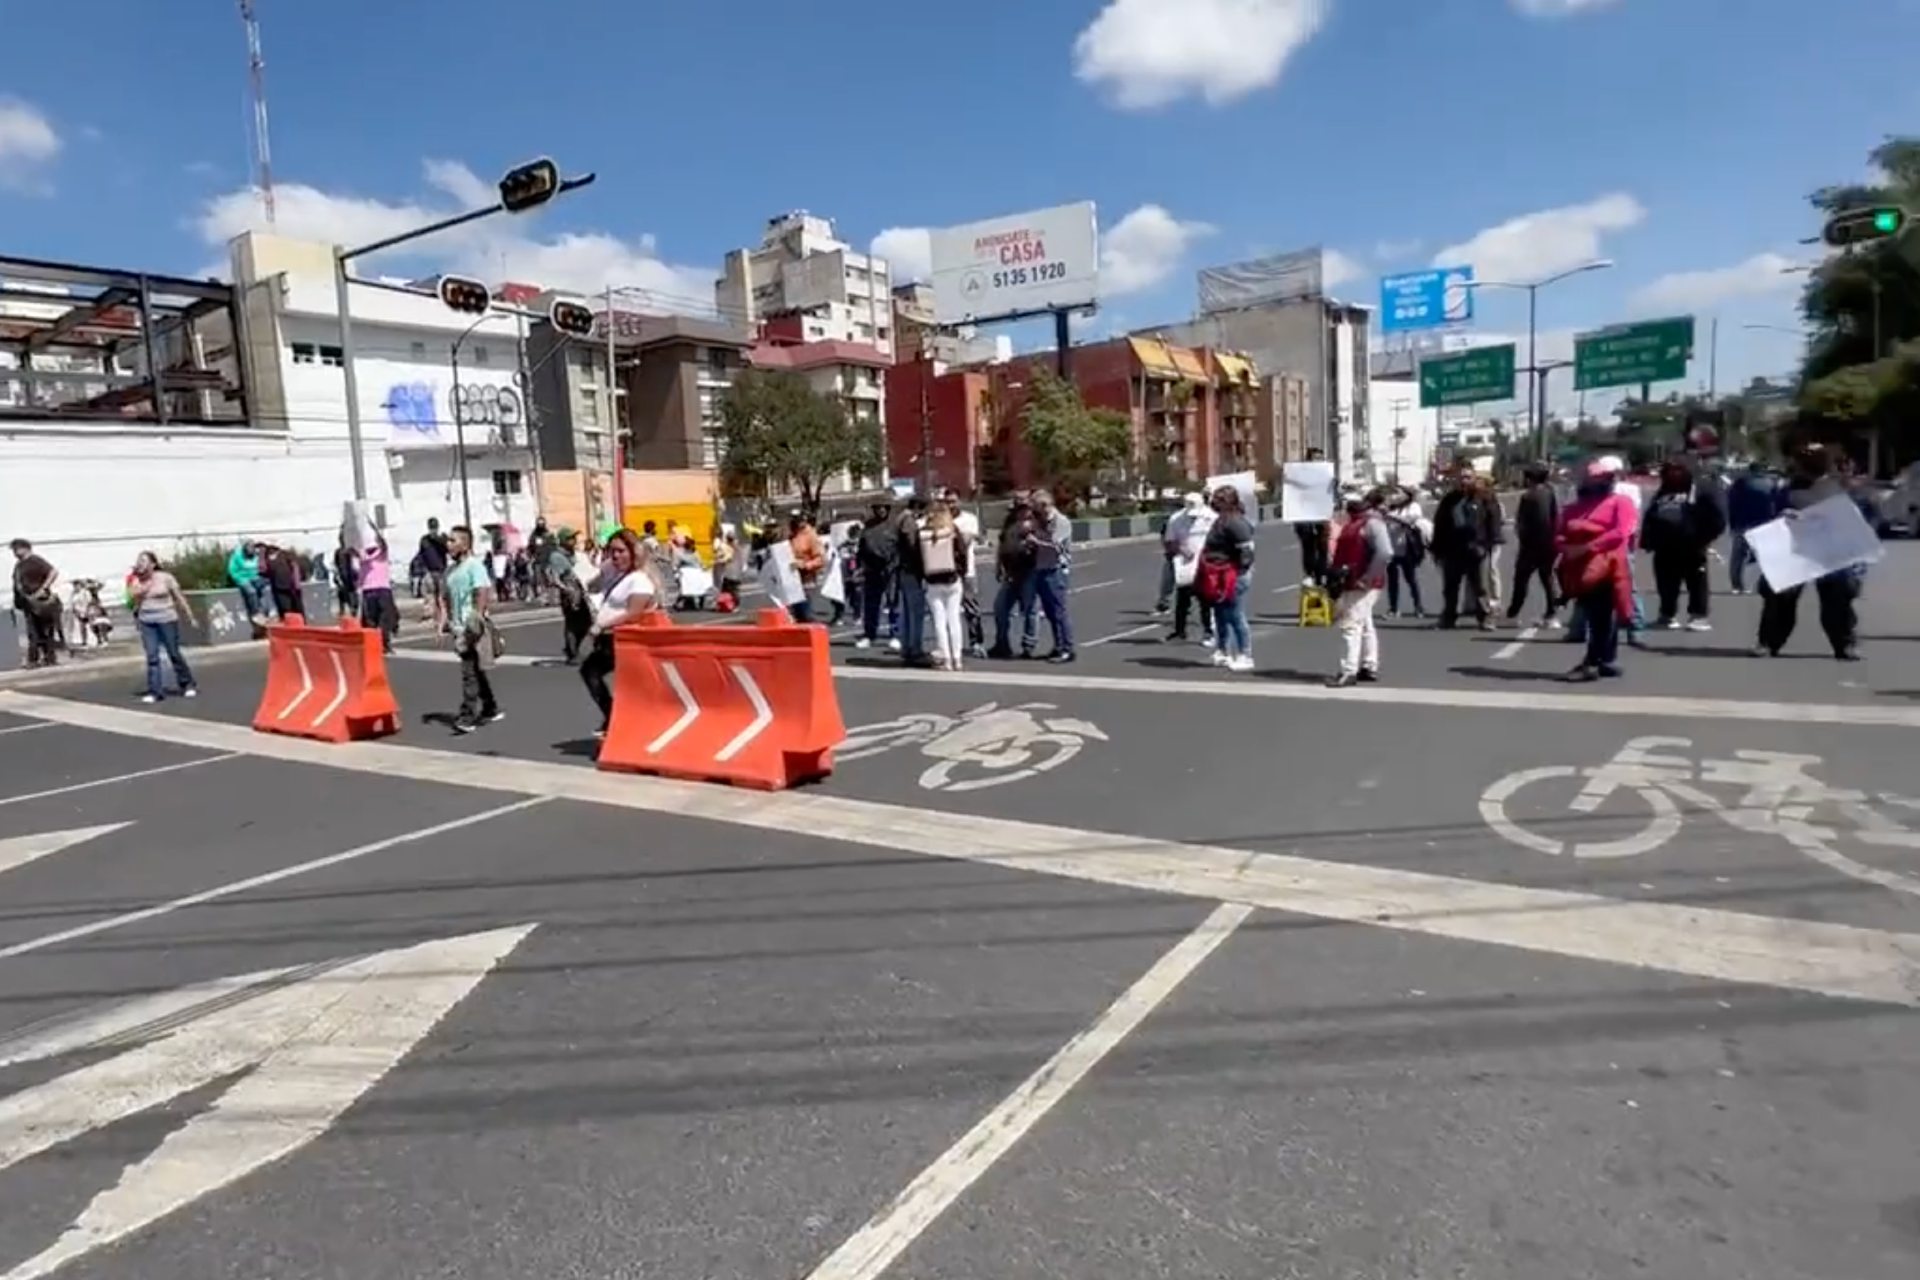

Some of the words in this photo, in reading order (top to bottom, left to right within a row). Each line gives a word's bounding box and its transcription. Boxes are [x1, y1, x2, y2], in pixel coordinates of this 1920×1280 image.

[1000, 239, 1045, 265] CASA
[993, 268, 1027, 288] 5135
[1031, 261, 1066, 282] 1920
